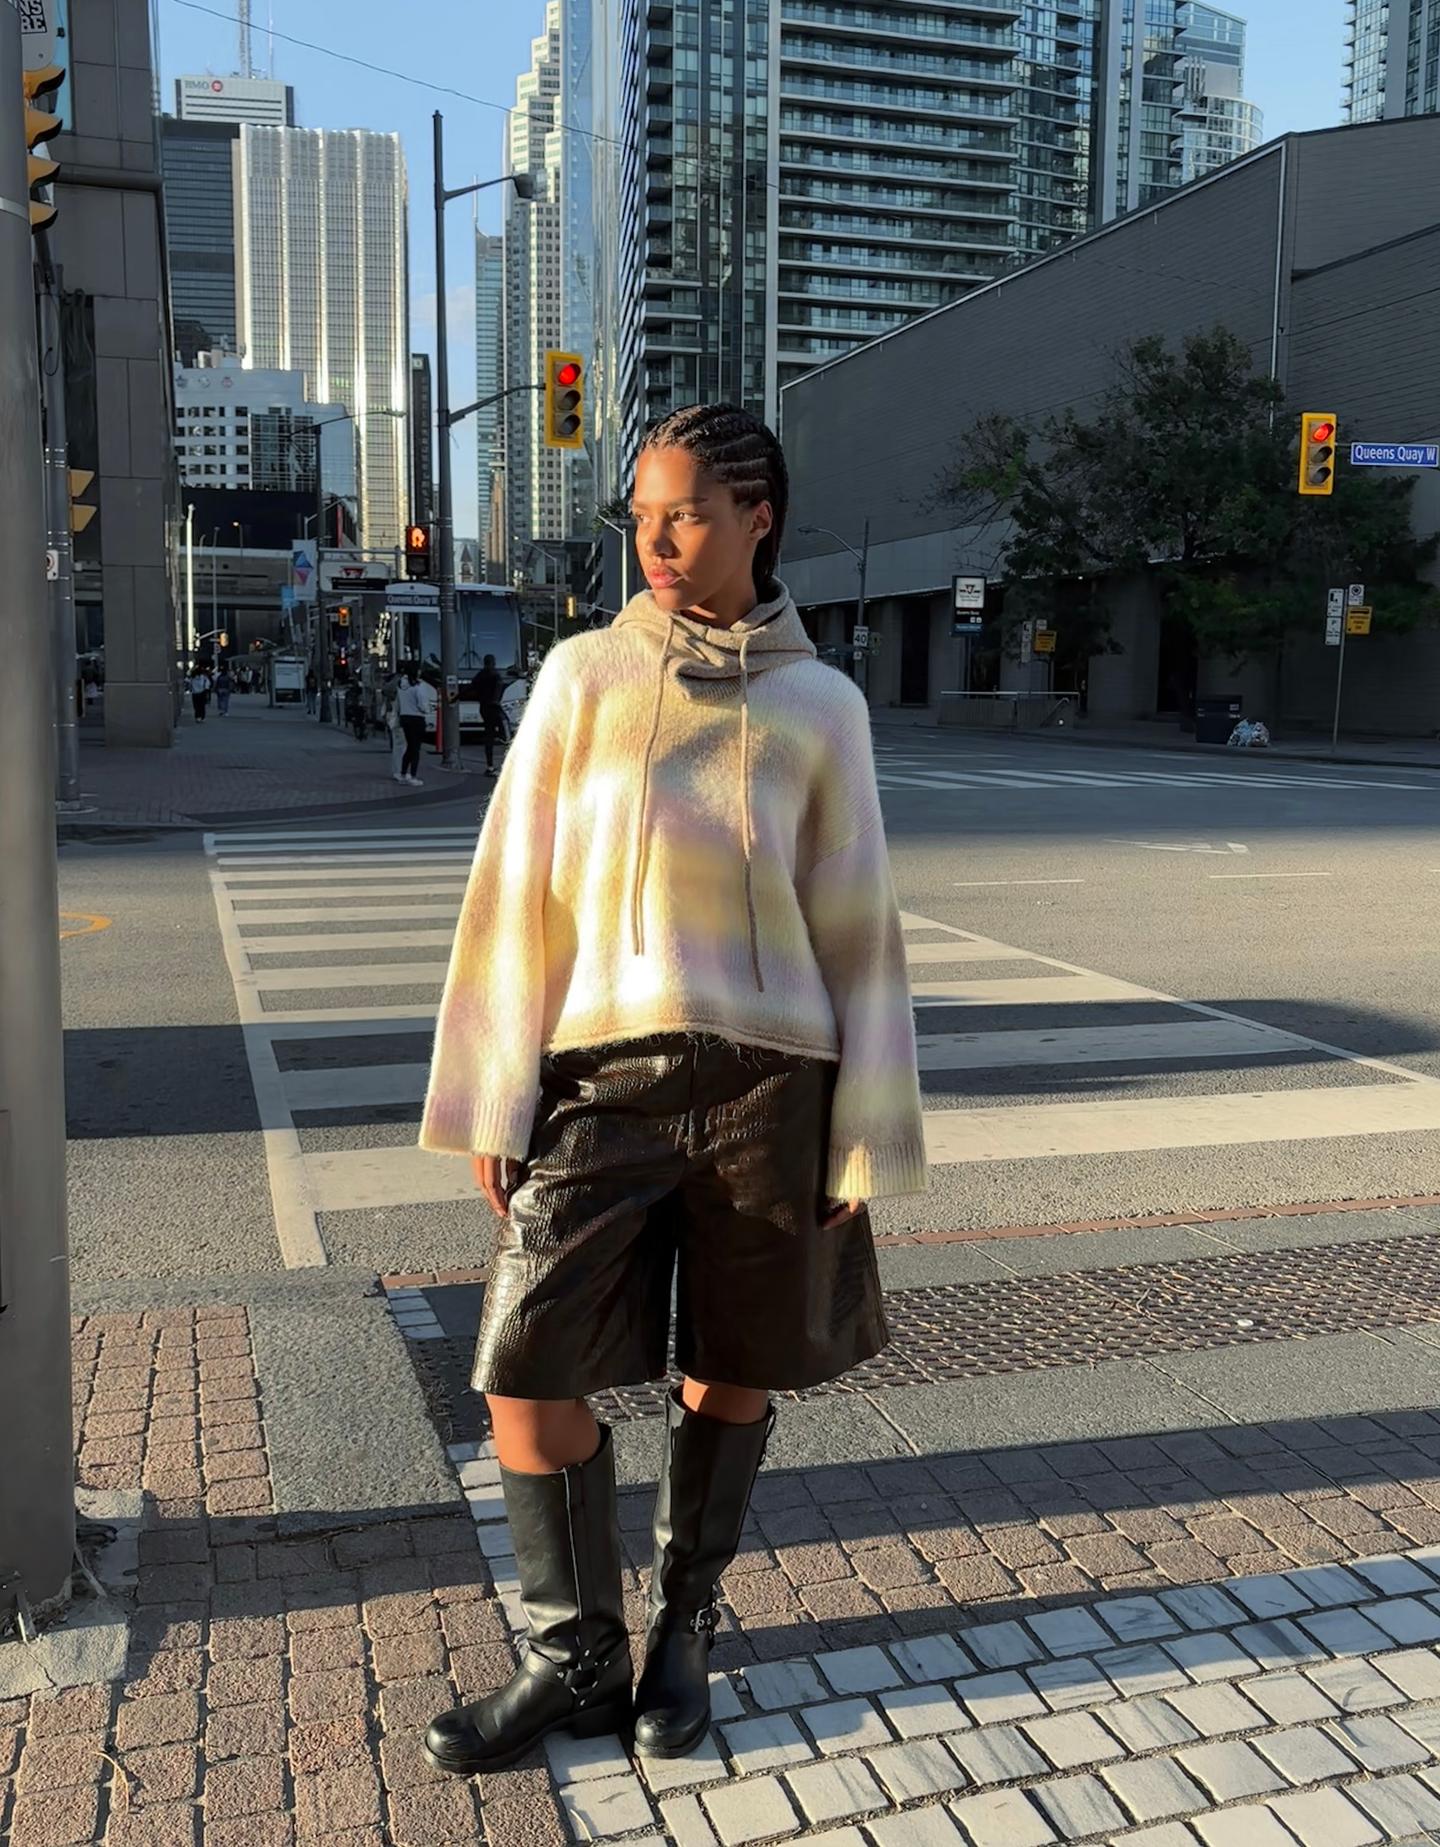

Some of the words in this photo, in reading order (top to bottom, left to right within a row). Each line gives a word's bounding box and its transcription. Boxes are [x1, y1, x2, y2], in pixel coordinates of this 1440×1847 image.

[1355, 445, 1395, 461] Queens
[1397, 446, 1424, 464] Quay
[1426, 447, 1436, 461] W
[855, 633, 867, 644] 40
